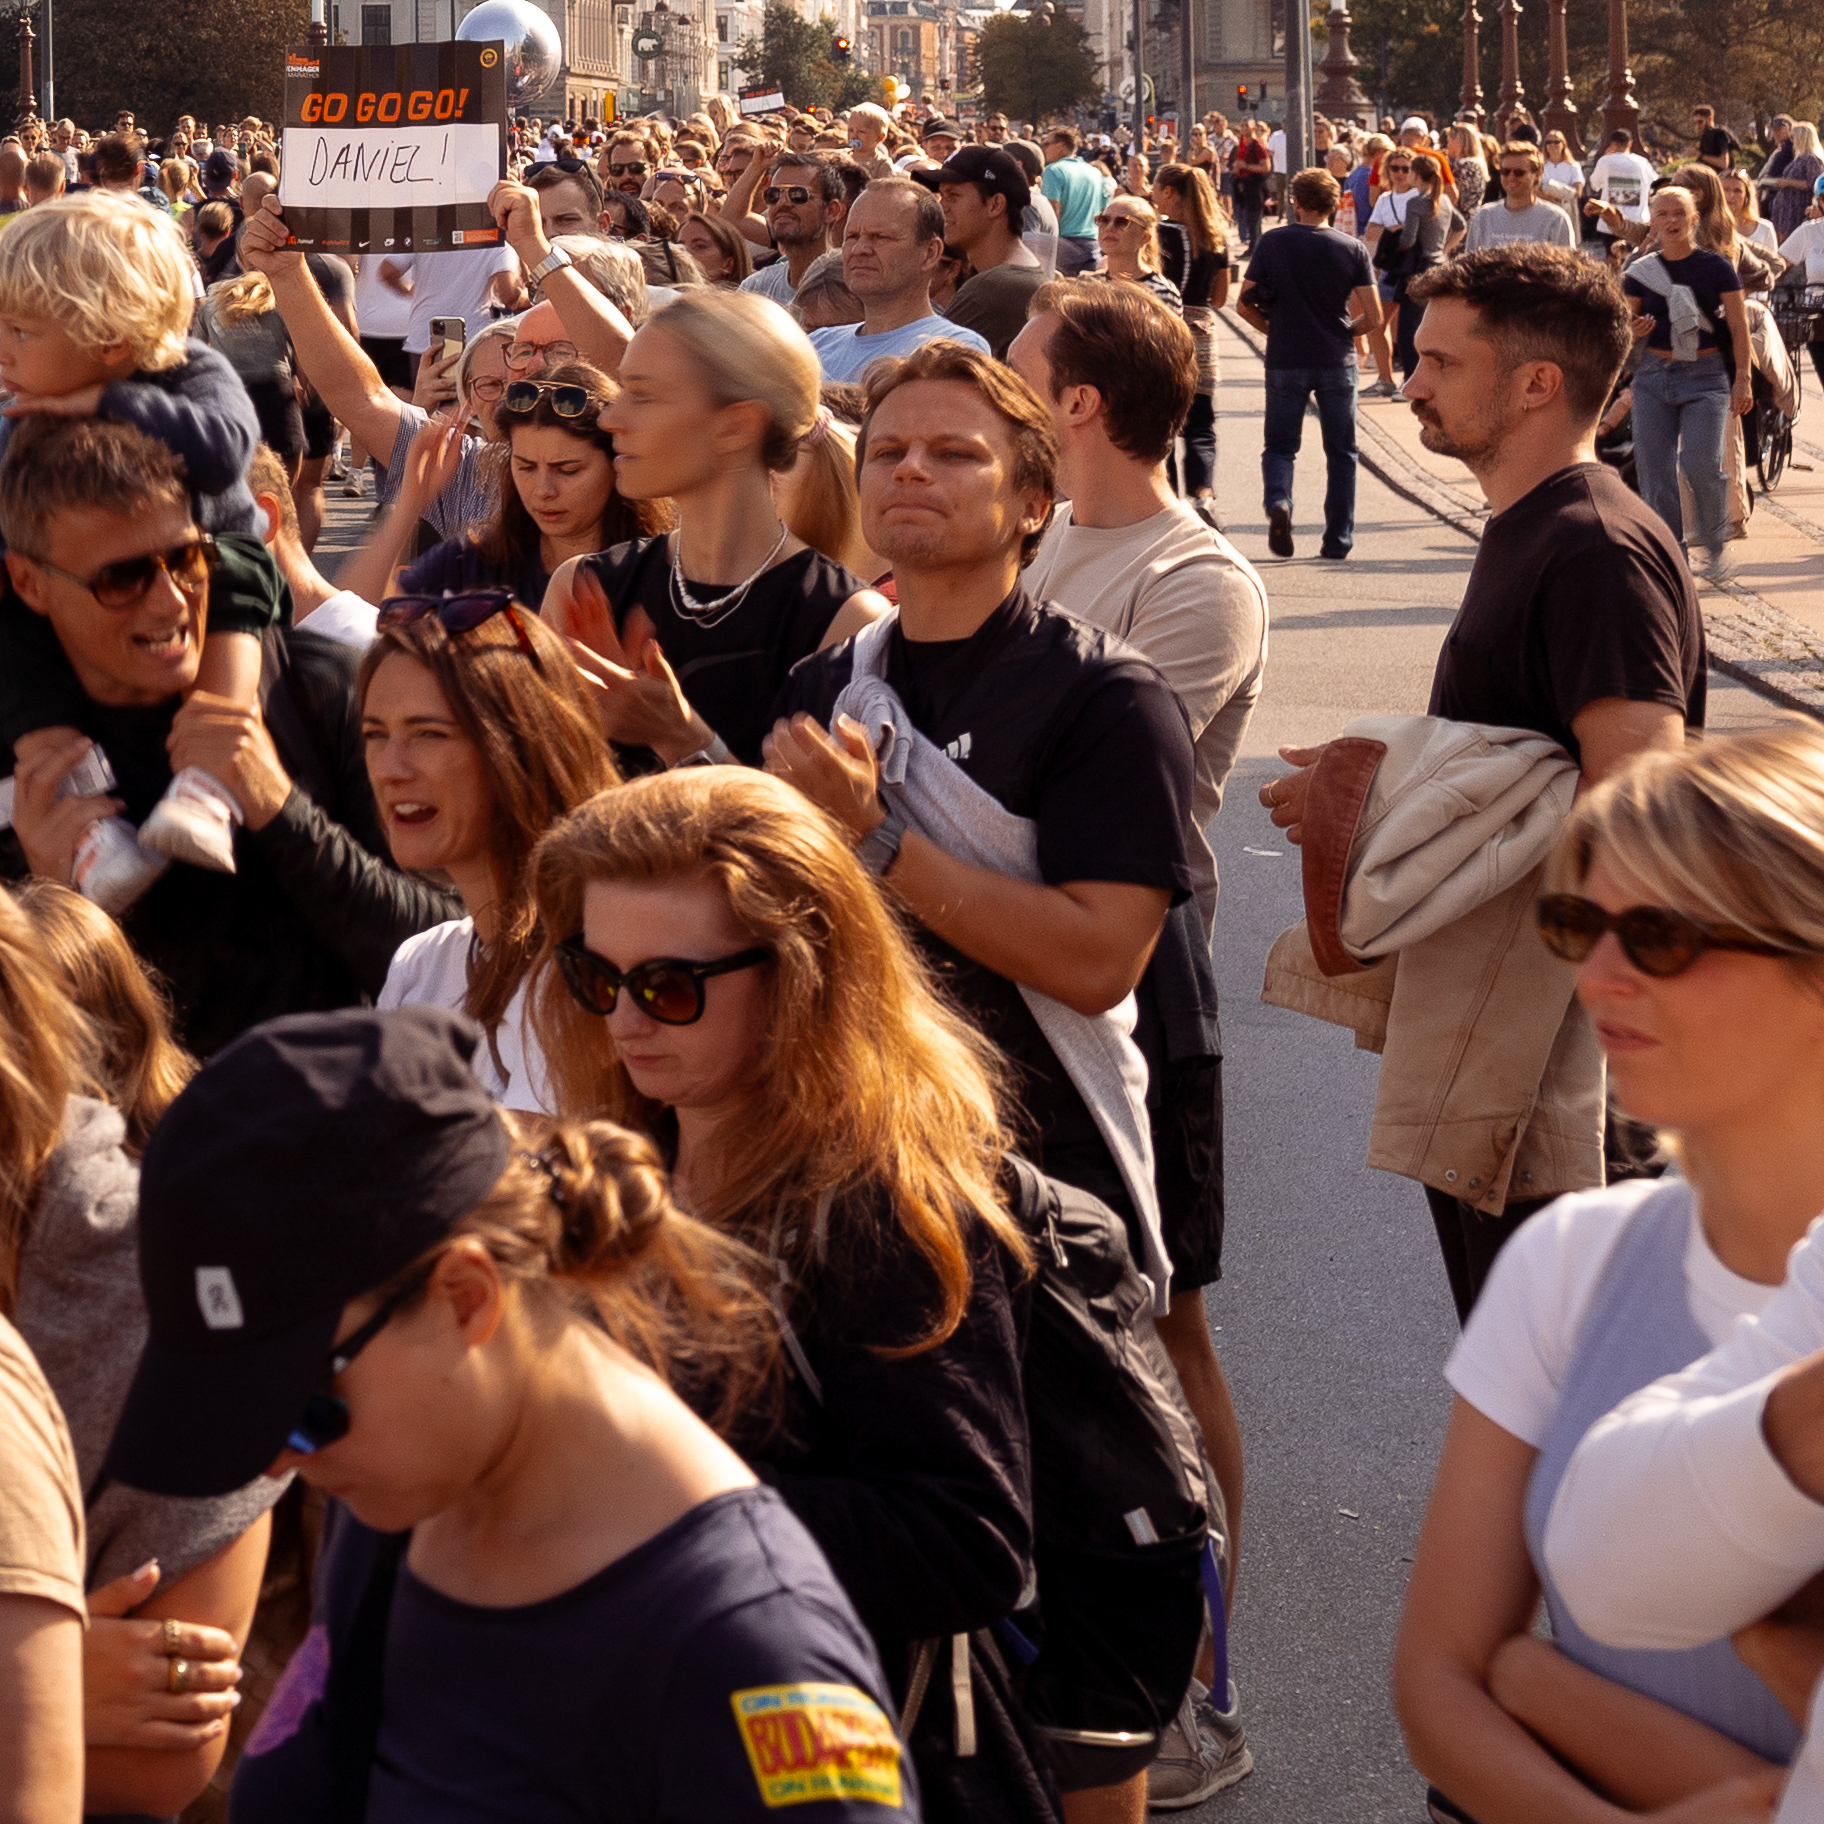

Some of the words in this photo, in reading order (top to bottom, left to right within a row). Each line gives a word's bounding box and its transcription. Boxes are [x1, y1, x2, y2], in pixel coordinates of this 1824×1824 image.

[301, 93, 348, 122] GO
[356, 92, 402, 122] GO
[408, 88, 469, 121] GO!
